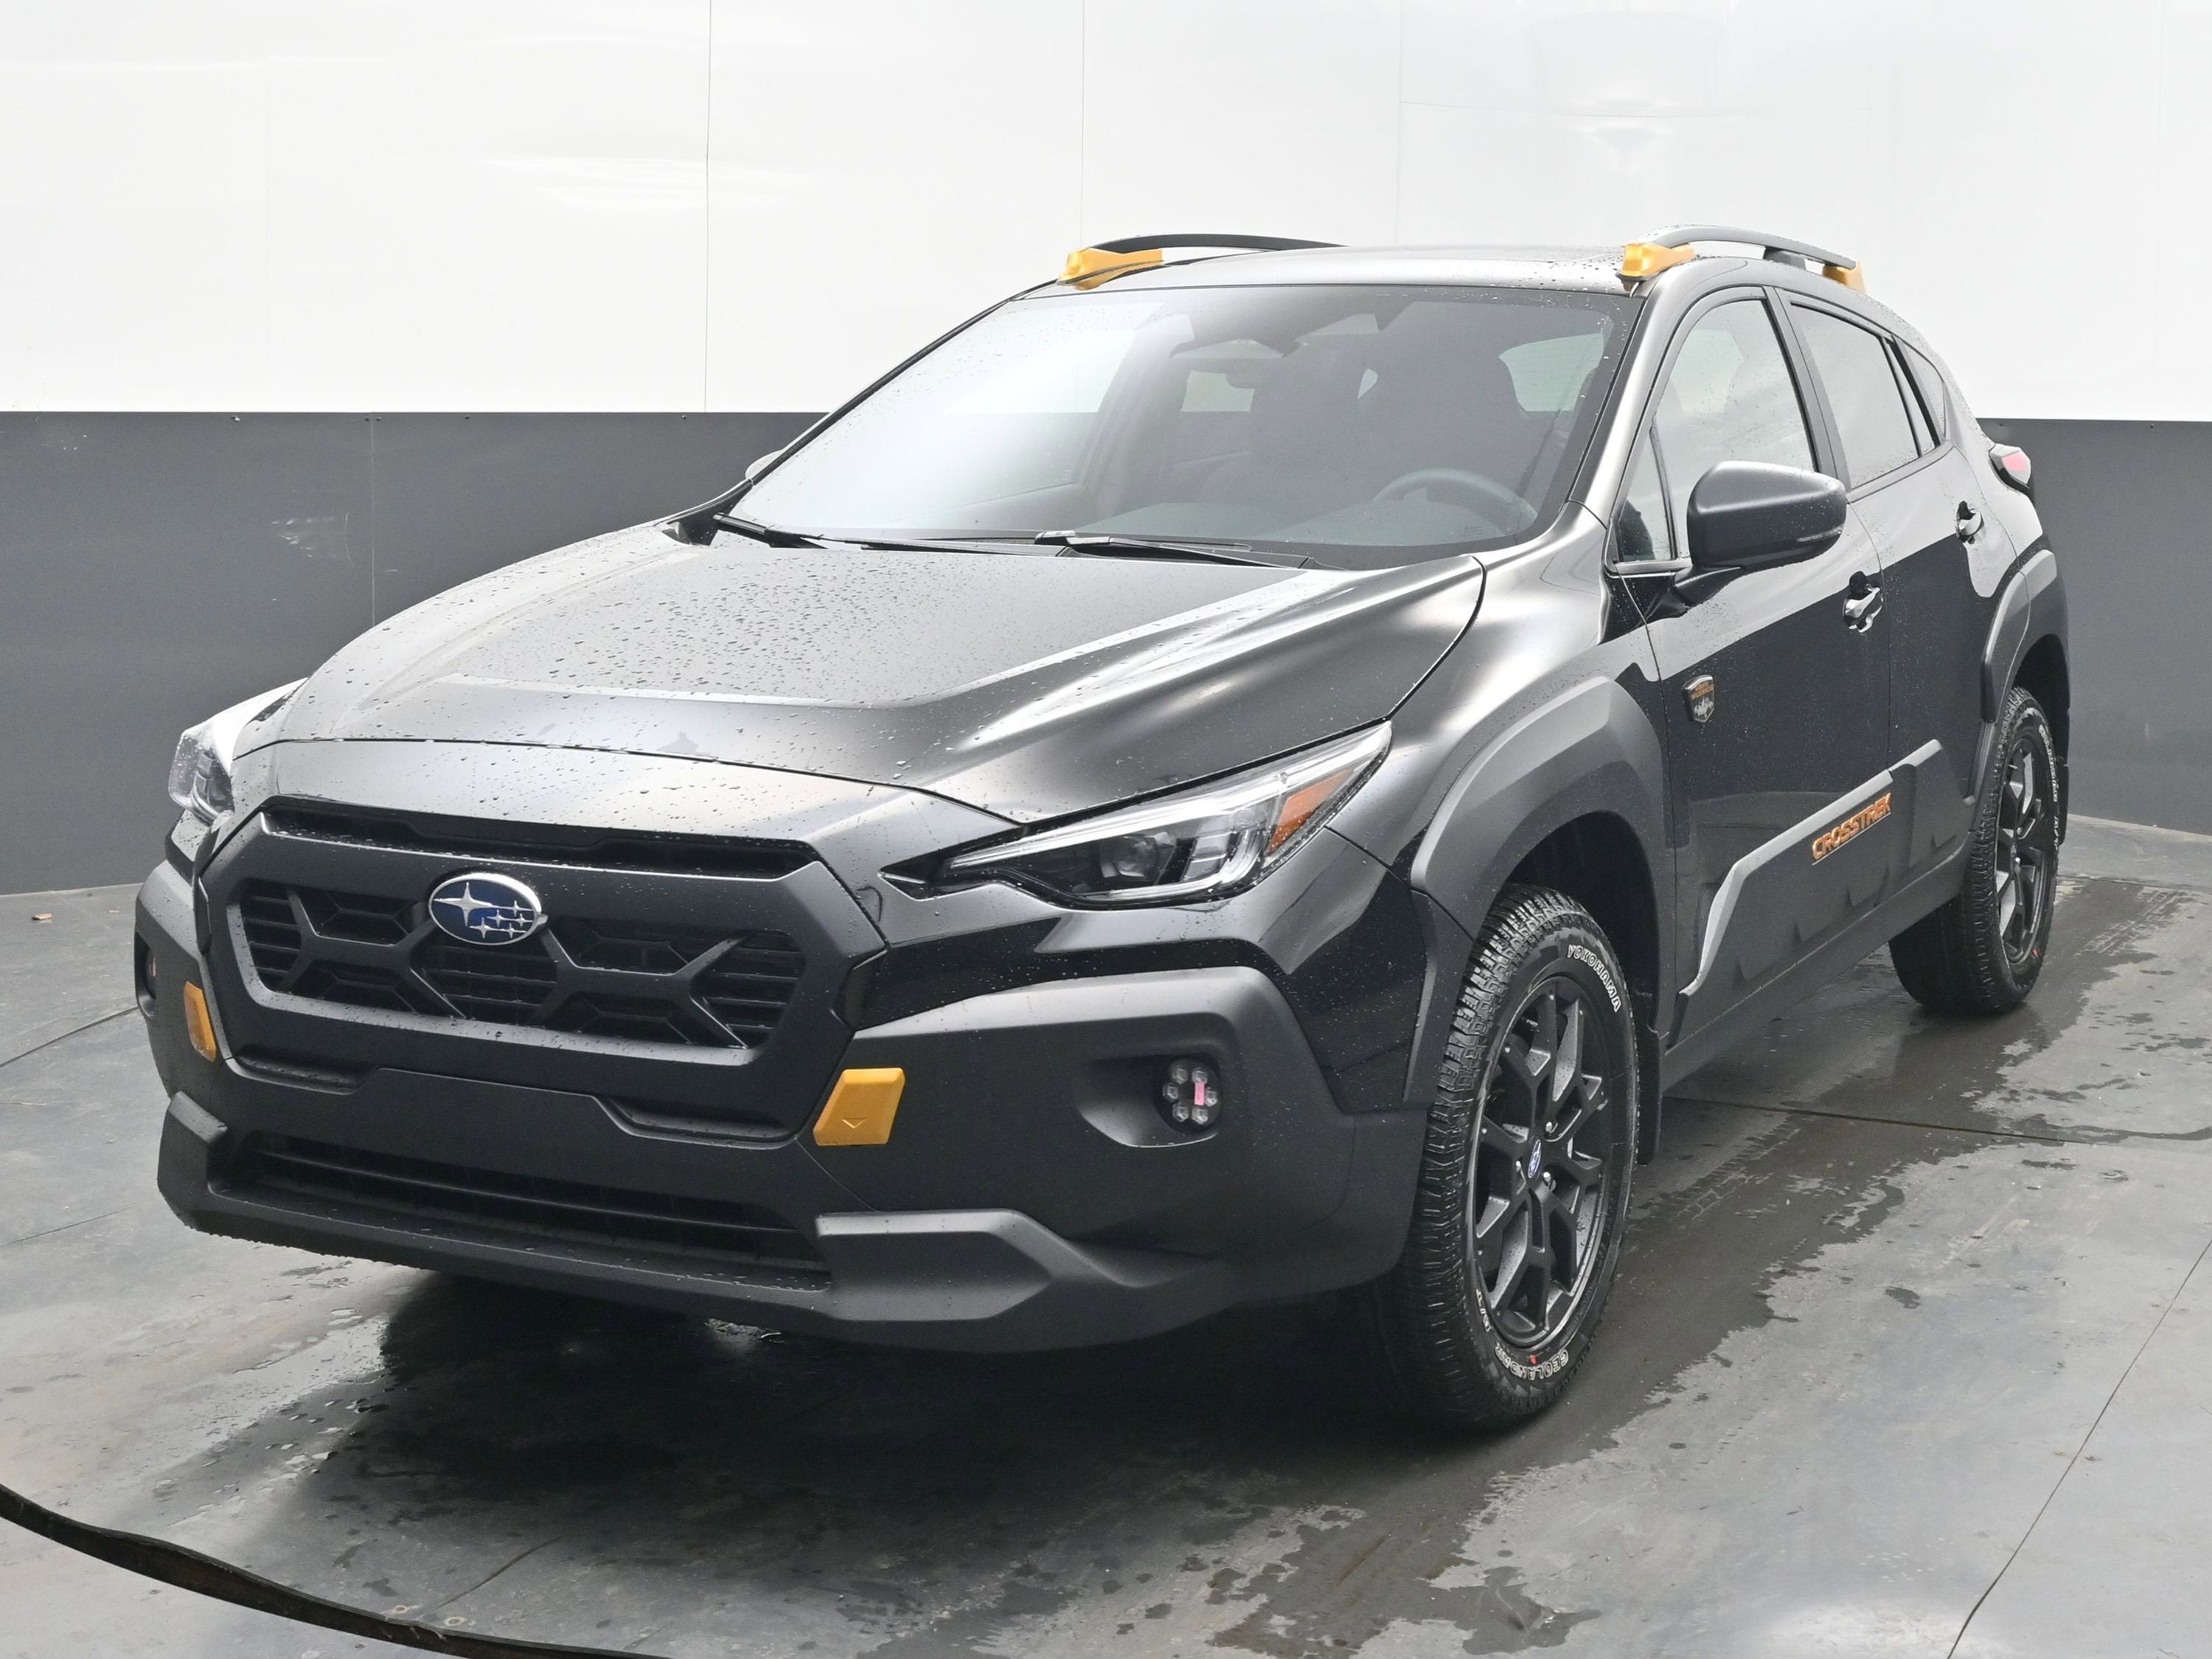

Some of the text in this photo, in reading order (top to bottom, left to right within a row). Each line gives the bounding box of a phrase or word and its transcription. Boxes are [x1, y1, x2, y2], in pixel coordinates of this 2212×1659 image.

[1812, 792, 1892, 860] CROSSTREK
[1567, 944, 1621, 1013] YOKOHAMA
[1495, 1342, 1569, 1381] GEOLANDAR
